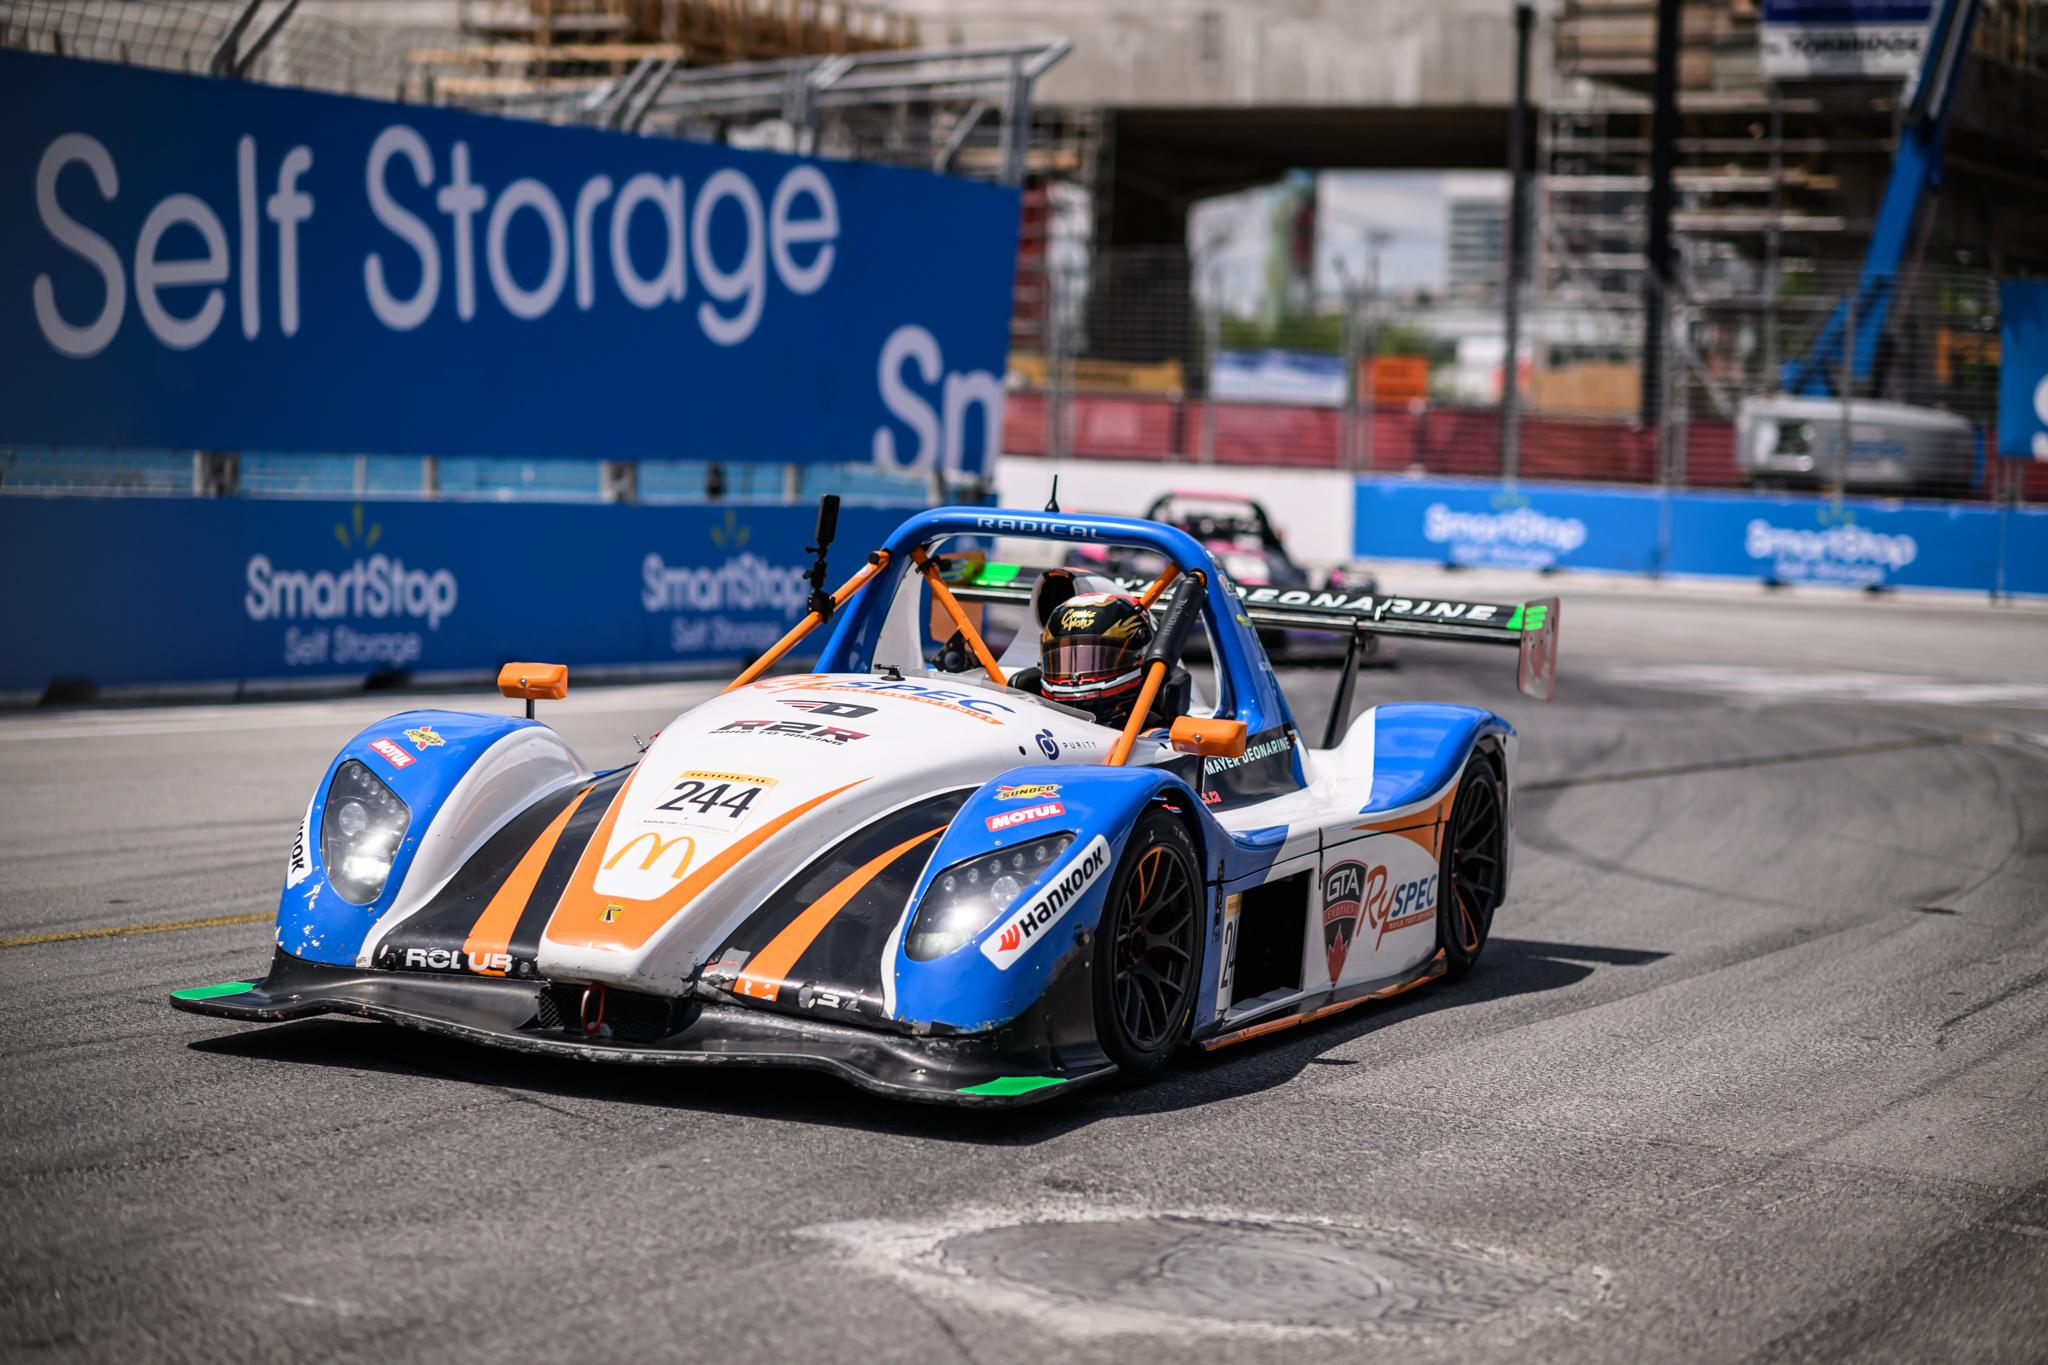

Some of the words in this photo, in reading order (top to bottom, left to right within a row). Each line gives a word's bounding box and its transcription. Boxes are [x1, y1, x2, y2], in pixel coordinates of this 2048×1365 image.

[33, 132, 314, 359] Self
[364, 124, 841, 346] Storage
[977, 517, 1106, 540] RADICAL
[245, 553, 459, 631] SmartStop
[641, 551, 812, 621] SmartStop
[284, 626, 330, 666] Self
[332, 625, 424, 668] Storage
[717, 720, 871, 743] R2R
[371, 739, 412, 767] MOTUL
[1062, 741, 1097, 750] PURITY
[690, 772, 771, 784] RADICAL
[1002, 785, 1055, 798] SUNOCO
[655, 780, 763, 819] 244
[992, 804, 1061, 830] MOTUL
[1327, 868, 1360, 902] GTA
[1327, 905, 1355, 921] EXOTICS
